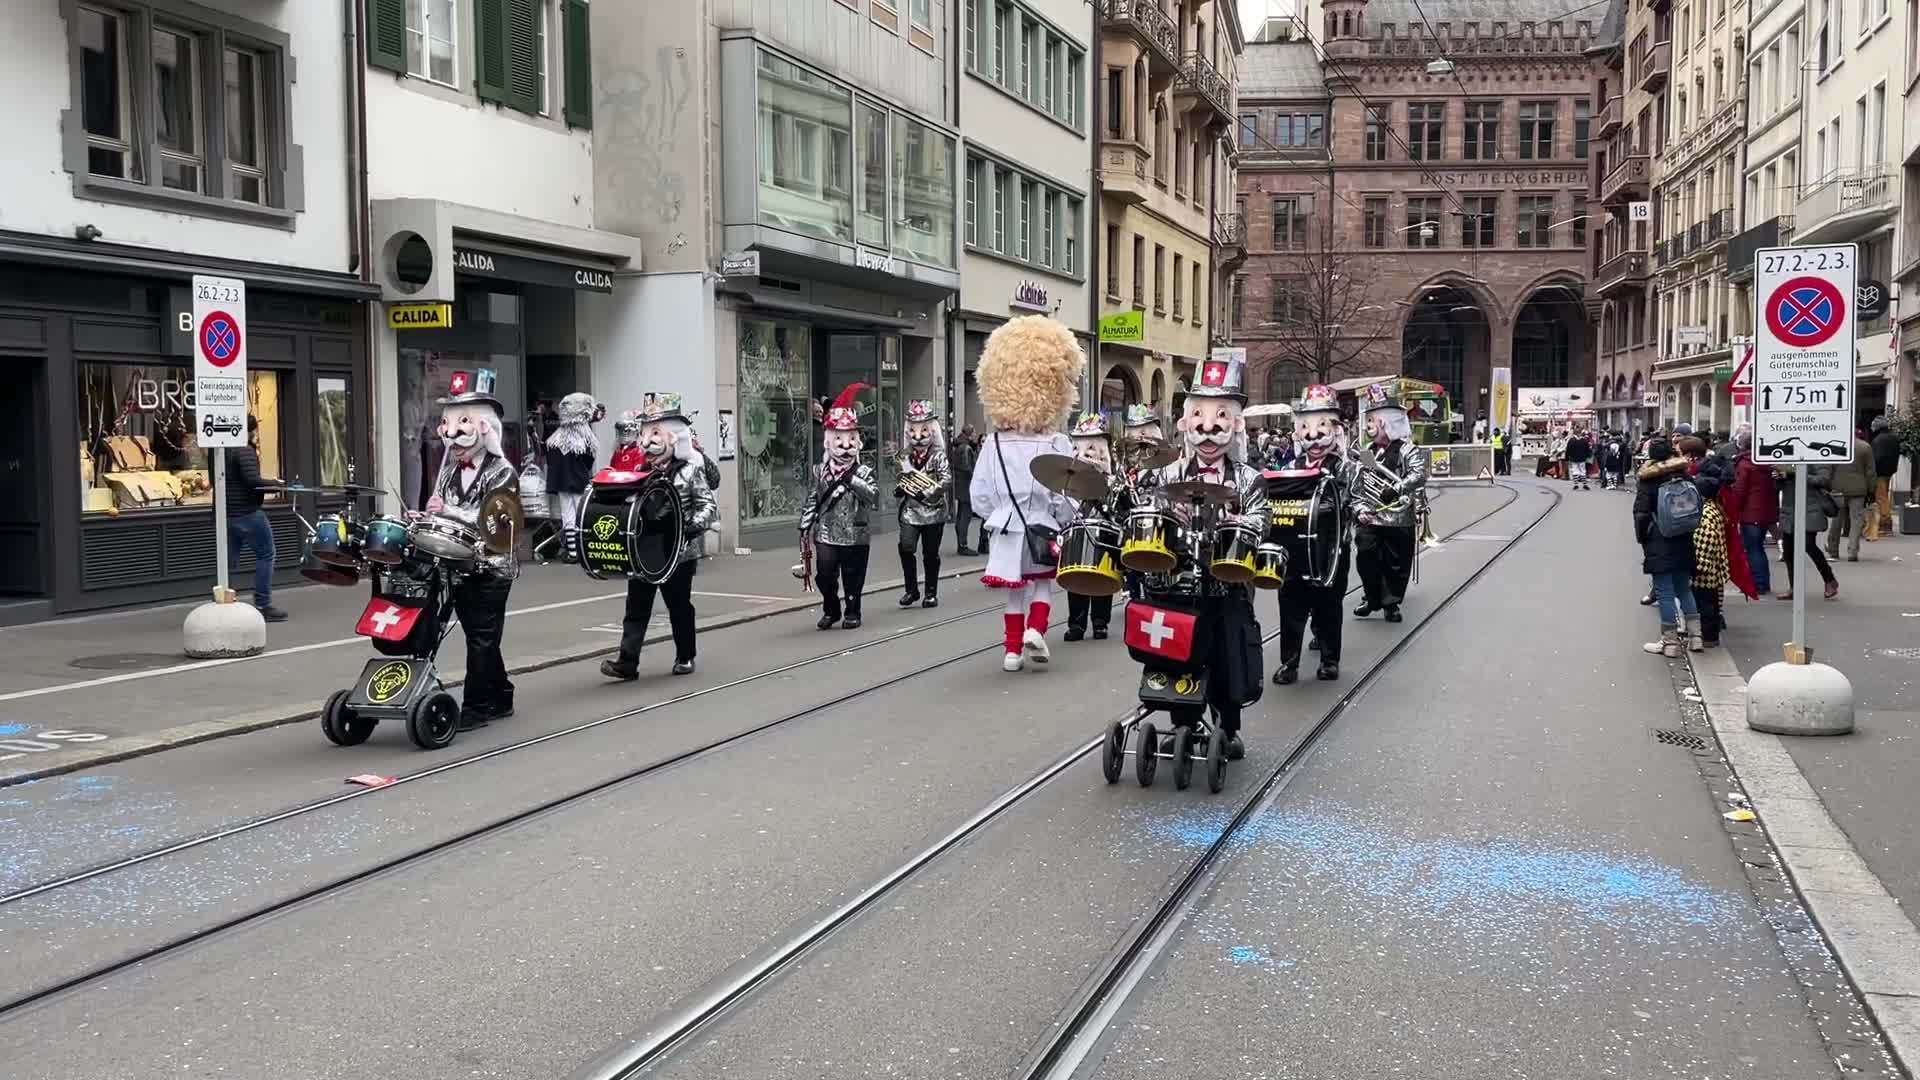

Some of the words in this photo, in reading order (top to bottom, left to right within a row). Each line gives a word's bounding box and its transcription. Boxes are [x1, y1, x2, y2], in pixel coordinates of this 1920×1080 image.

[1634, 205, 1648, 217] 18
[575, 270, 612, 288] CALIDA
[392, 310, 440, 323] CALIDA
[1770, 351, 1838, 360] ausgenommen
[1769, 359, 1839, 369] Güterumschlag
[1790, 415, 1816, 423] beide
[1770, 423, 1837, 432] Strassenseiten
